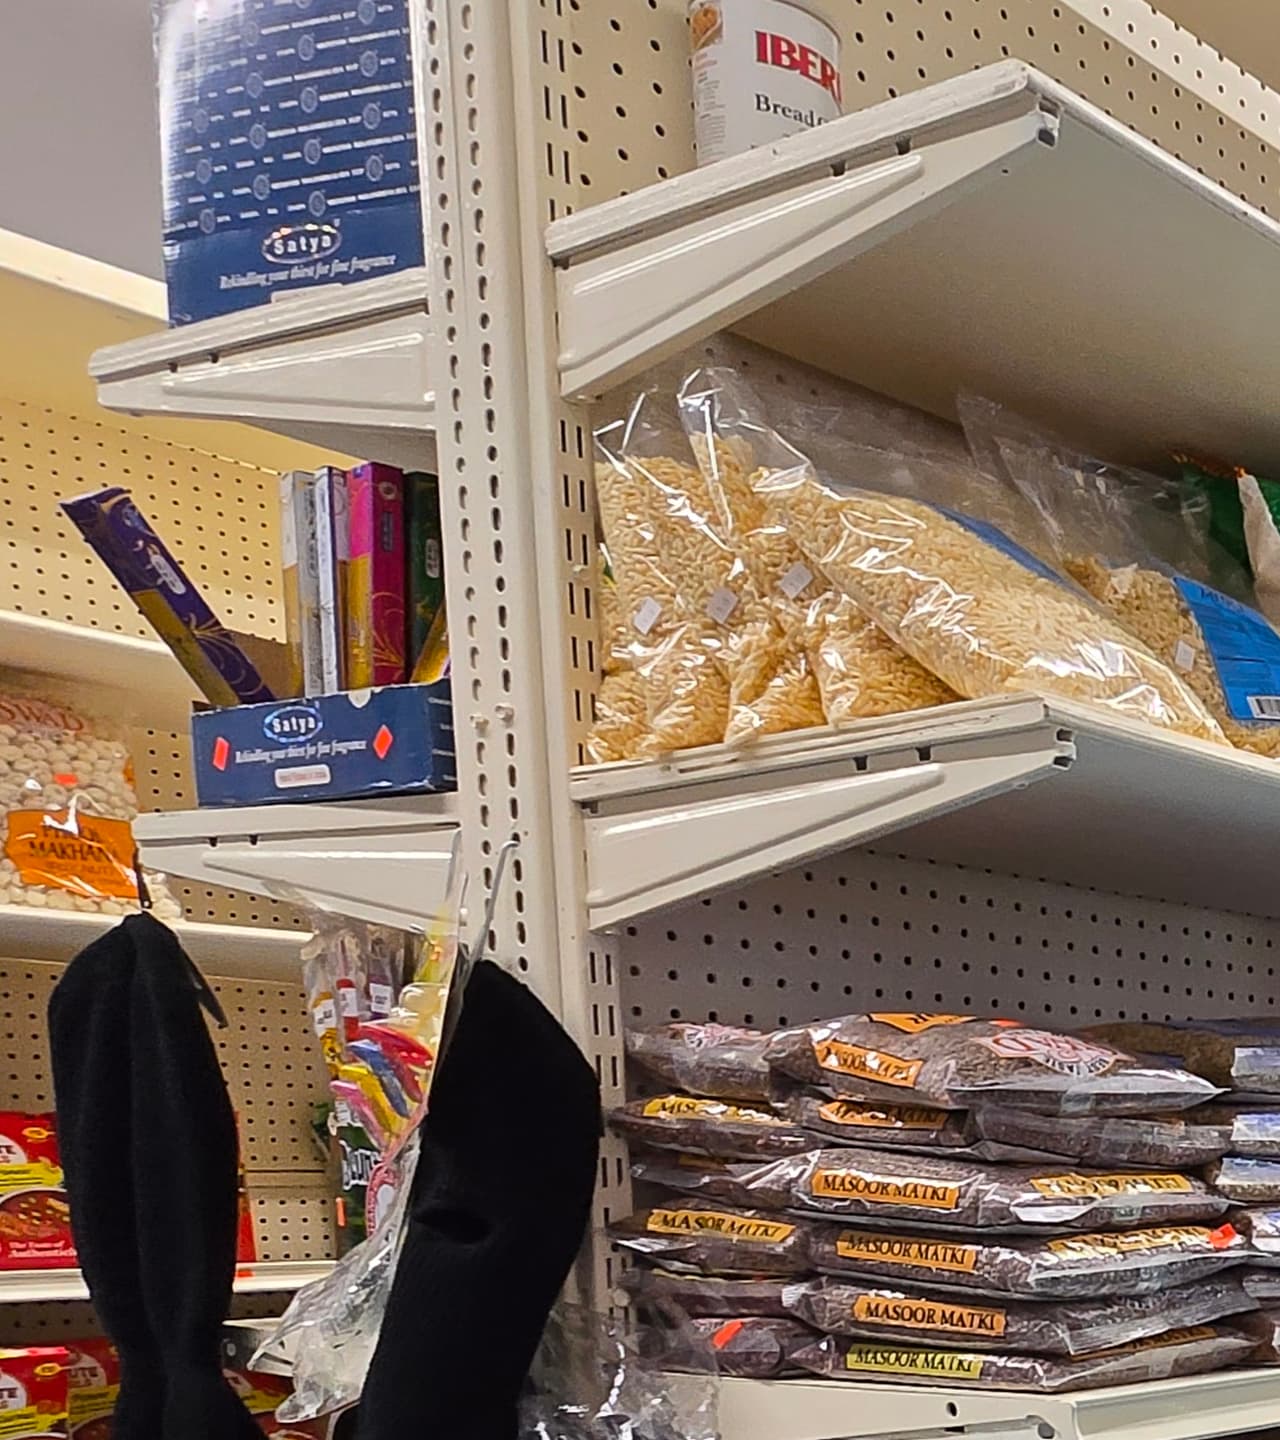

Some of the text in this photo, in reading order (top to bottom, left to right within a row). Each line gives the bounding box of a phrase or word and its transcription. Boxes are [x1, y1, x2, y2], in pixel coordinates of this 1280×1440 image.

[274, 233, 332, 256] Satya
[272, 715, 316, 734] Satya
[822, 1175, 949, 1204] MASOOR MATKI
[847, 1235, 968, 1266] MASOOR MATKI
[865, 1301, 996, 1331] MASOOR MATKI
[855, 1349, 972, 1373] MASOOR MATKI
